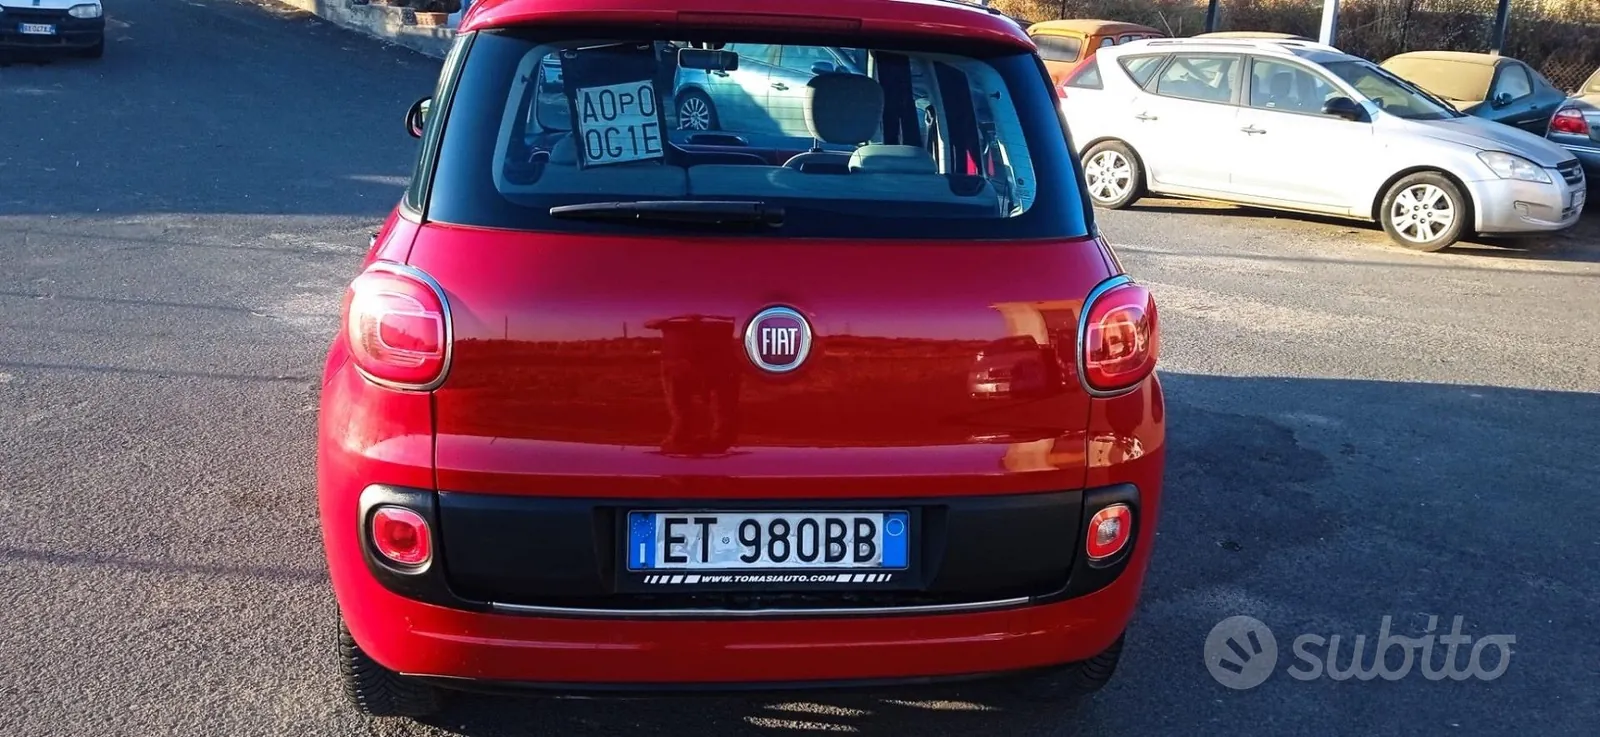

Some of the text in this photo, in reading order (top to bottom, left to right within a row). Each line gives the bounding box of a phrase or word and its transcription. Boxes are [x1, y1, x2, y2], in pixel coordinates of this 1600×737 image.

[762, 327, 798, 355] FIAT
[663, 517, 718, 564] ET
[738, 517, 877, 564] 980BB
[701, 574, 837, 583] WWW.TOMASIAUTO.COM
